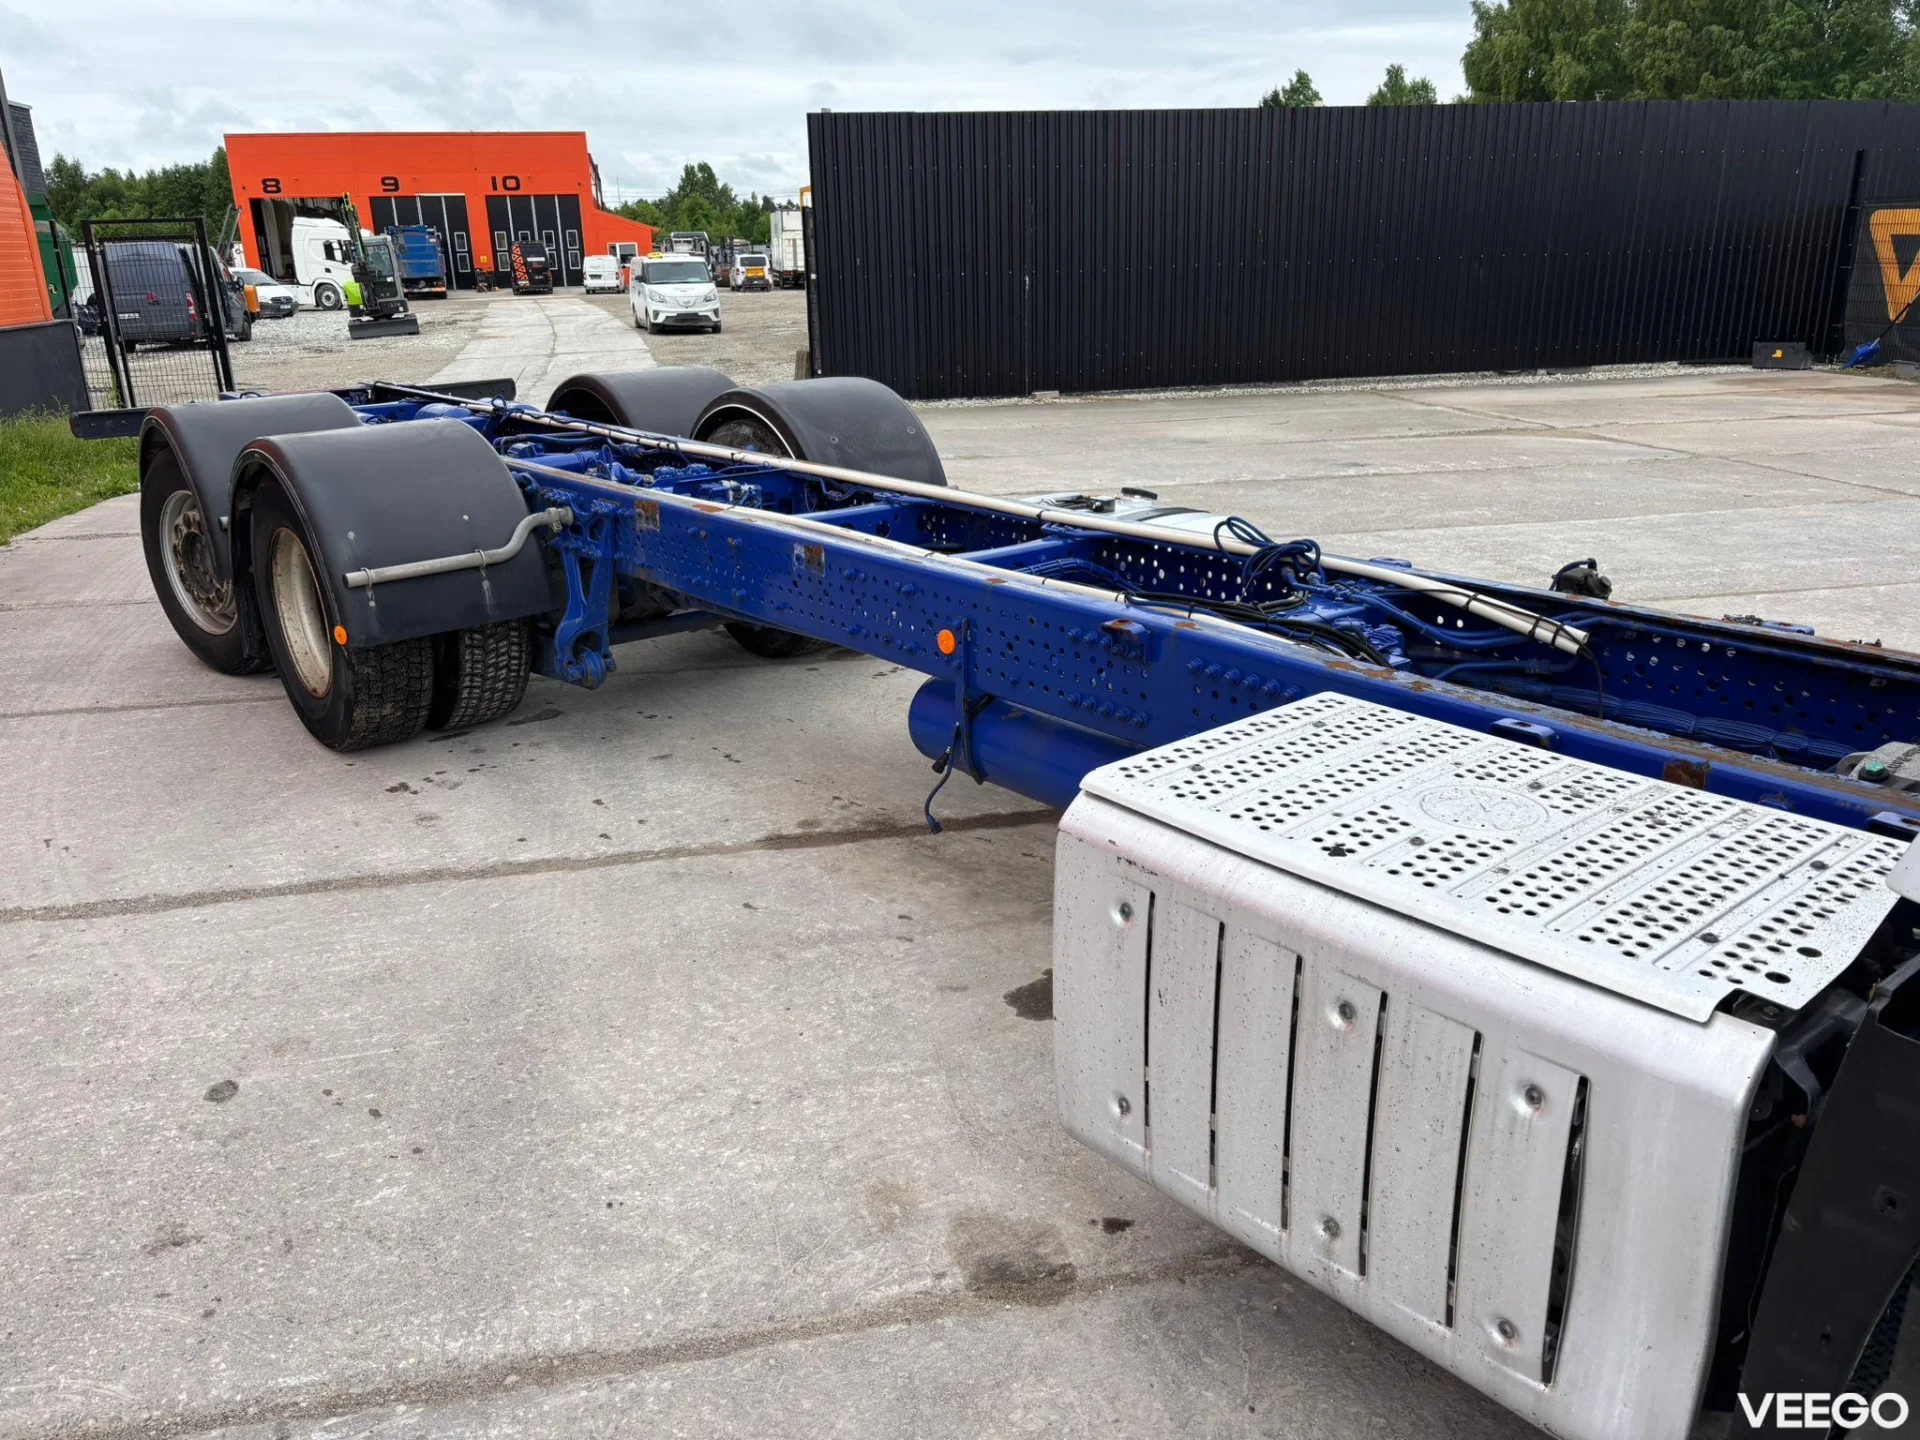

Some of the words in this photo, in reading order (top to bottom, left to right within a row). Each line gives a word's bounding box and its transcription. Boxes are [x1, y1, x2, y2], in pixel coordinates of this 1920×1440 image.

[261, 177, 282, 195] 8
[380, 176, 400, 192] 9
[491, 175, 521, 192] 10
